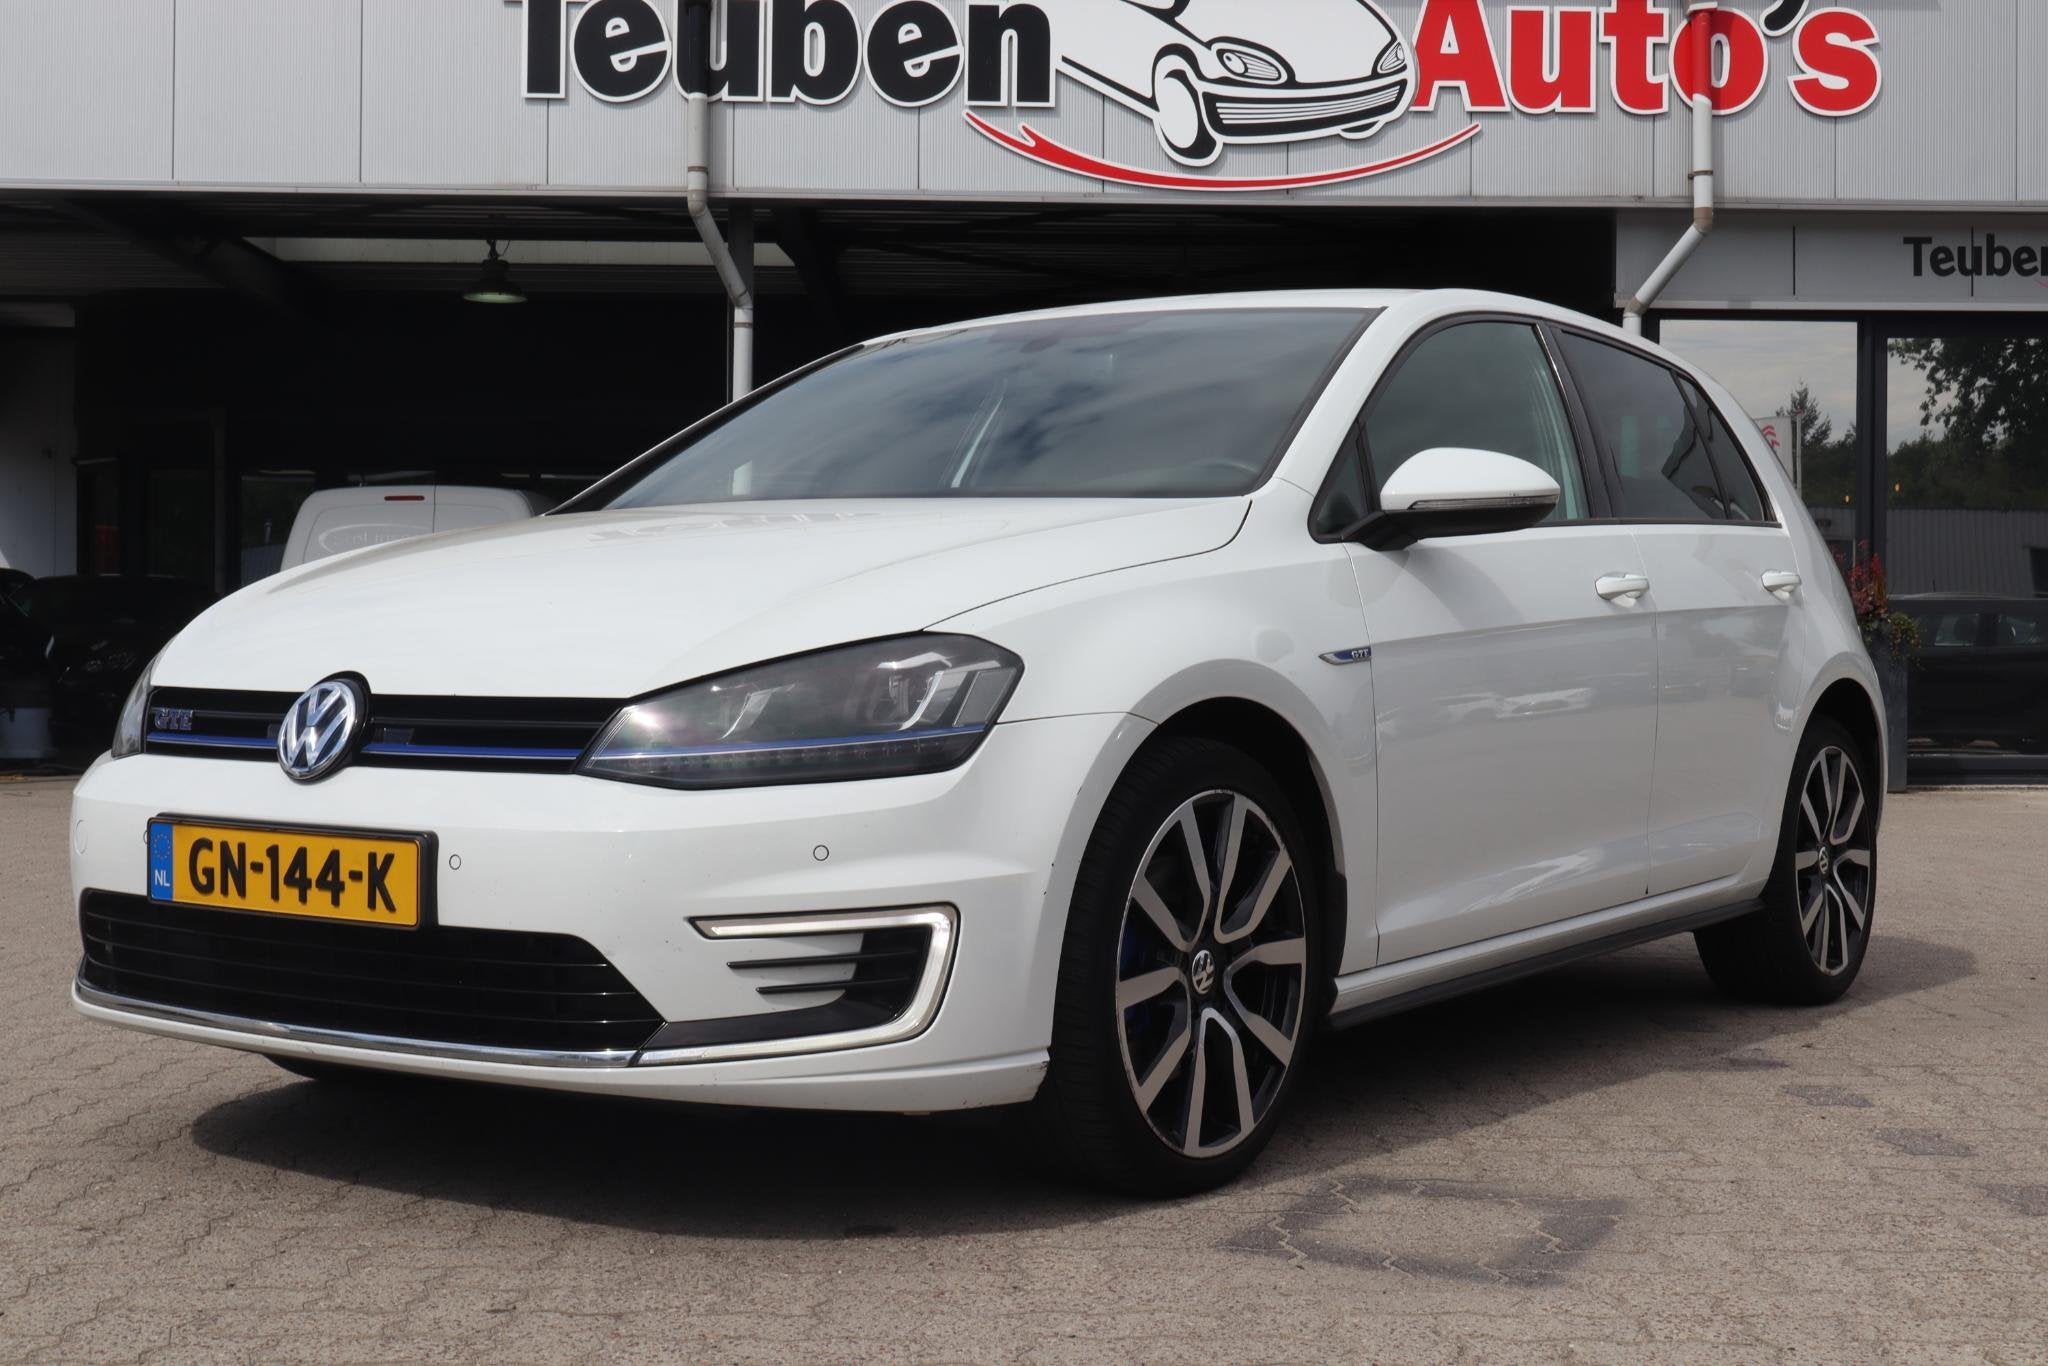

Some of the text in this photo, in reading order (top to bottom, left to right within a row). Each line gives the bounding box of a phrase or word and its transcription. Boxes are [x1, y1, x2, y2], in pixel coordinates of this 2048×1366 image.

[1411, 0, 1880, 115] Auto's
[1903, 233, 2048, 277] Teube
[154, 707, 193, 730] GTE
[154, 869, 170, 887] NL
[188, 837, 397, 913] GN-144-K
